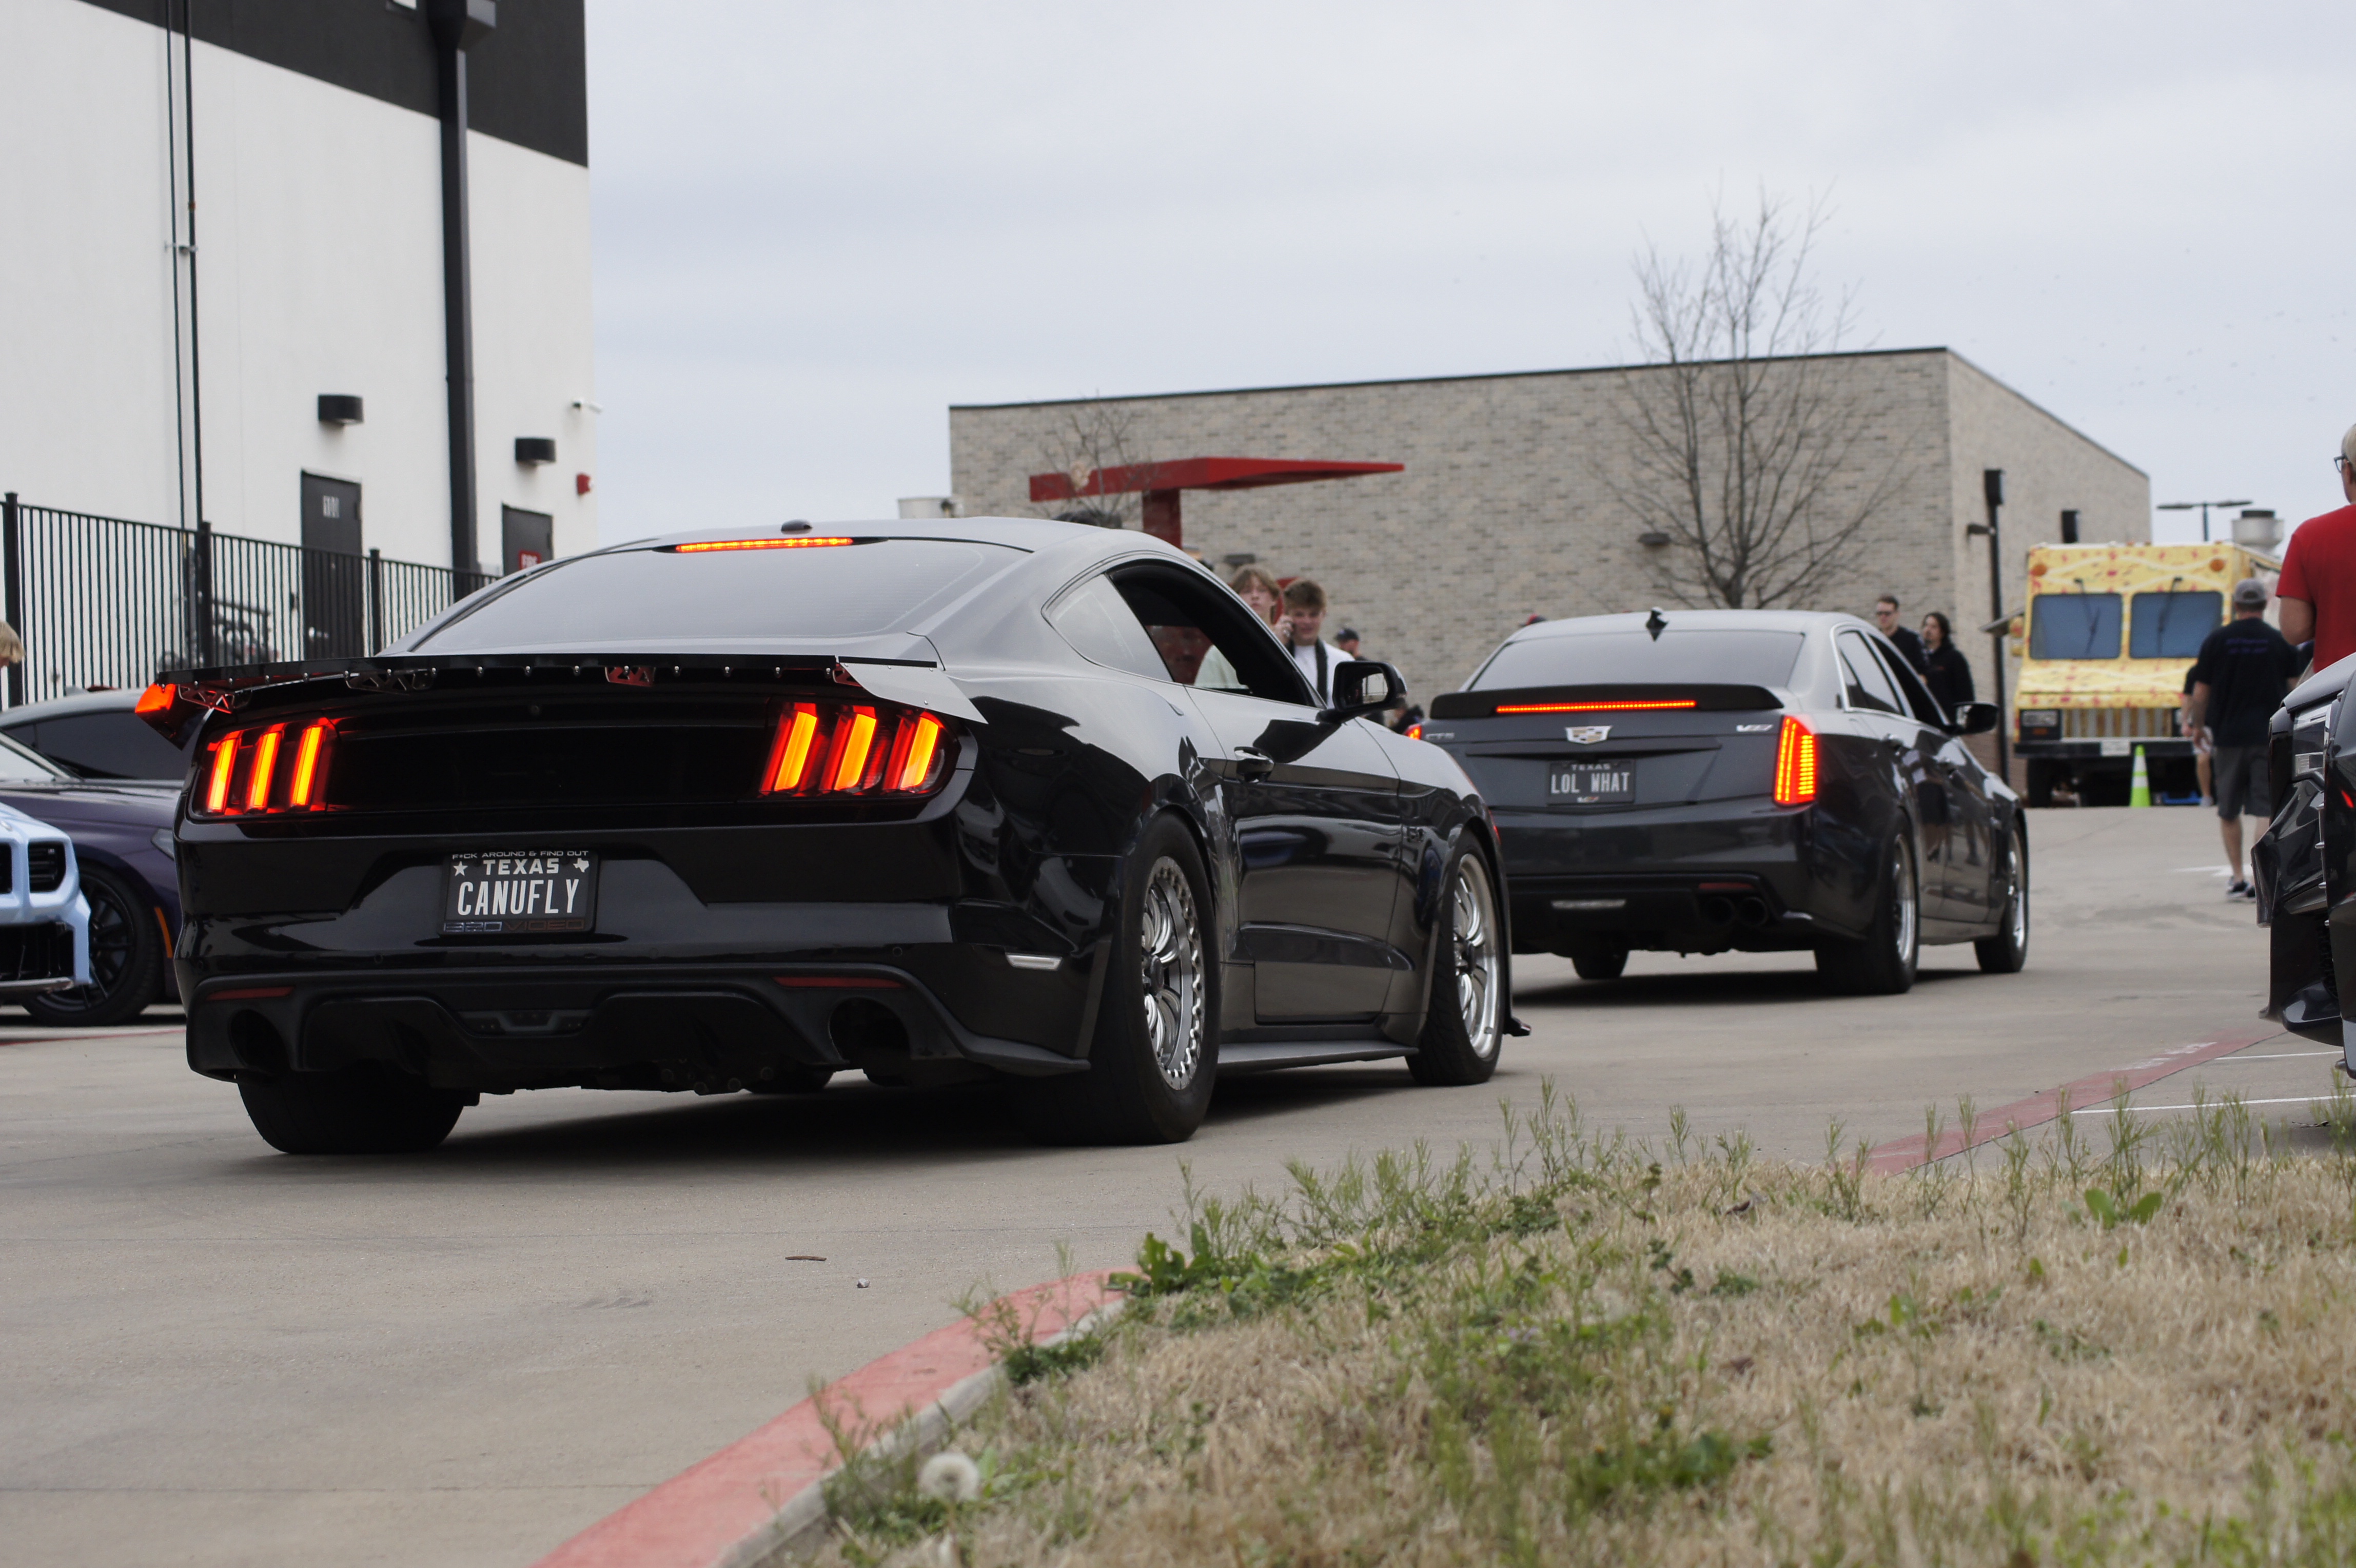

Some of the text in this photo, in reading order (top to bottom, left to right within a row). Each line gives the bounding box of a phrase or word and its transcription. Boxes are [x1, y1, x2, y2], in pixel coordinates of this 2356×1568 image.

[1551, 772, 1631, 794] LOL WHAT
[483, 857, 559, 875] TEXAS
[457, 878, 579, 915] CANUFLY
